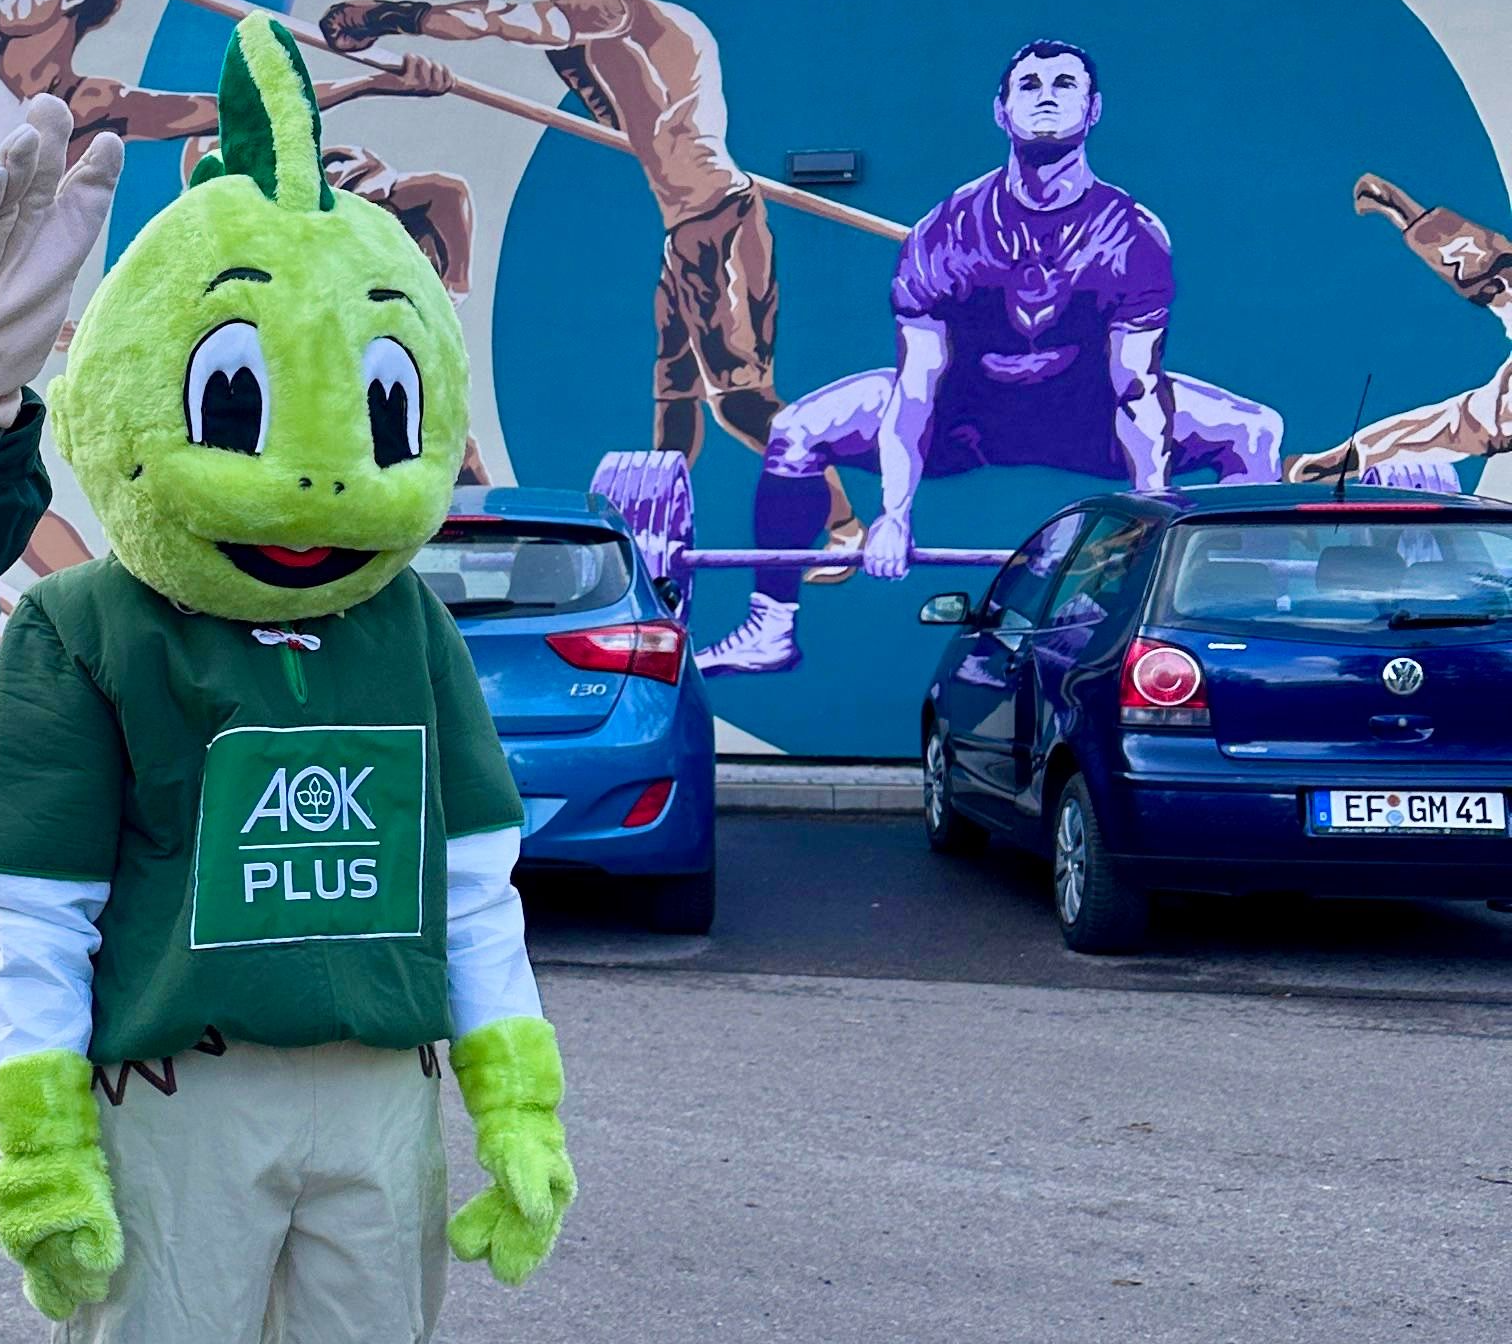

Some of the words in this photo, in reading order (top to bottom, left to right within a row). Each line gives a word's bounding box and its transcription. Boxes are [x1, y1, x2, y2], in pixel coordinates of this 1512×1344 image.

[240, 765, 377, 834] AOK
[1345, 794, 1386, 822] EF
[1408, 795, 1448, 823] GM
[1456, 796, 1493, 824] 41
[243, 859, 379, 903] PLUS
